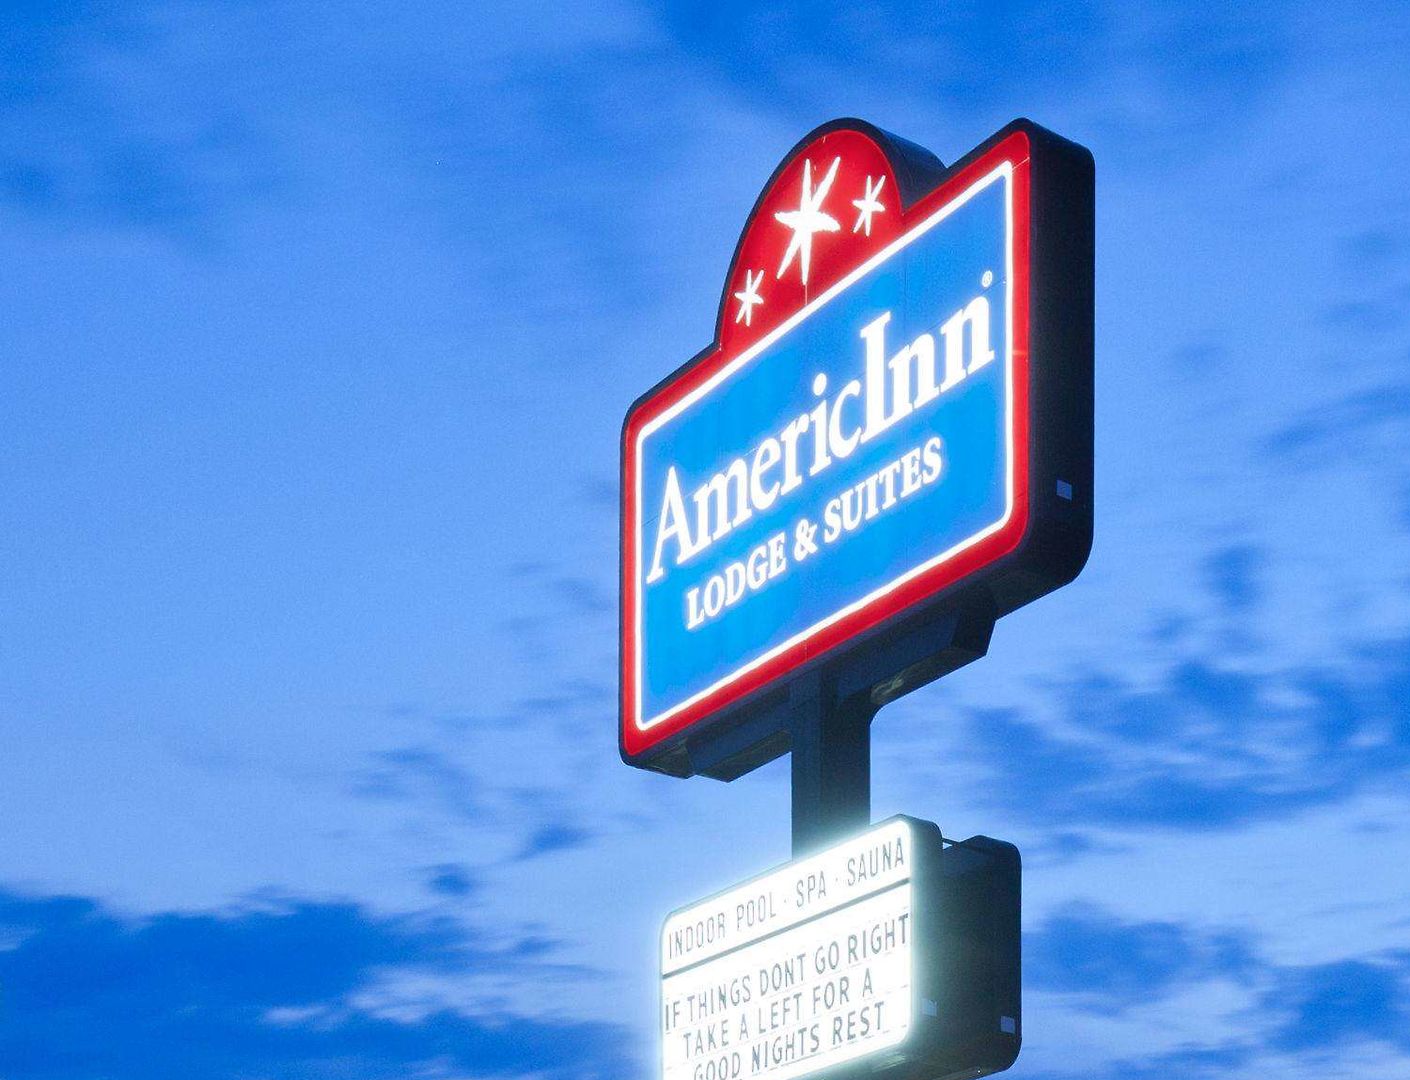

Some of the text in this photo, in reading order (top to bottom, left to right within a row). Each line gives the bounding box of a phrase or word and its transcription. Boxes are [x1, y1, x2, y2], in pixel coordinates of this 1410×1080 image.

[647, 295, 994, 583] AmericInn
[686, 436, 943, 630] LODGE & SUITES
[669, 838, 905, 959] INDOOR POOL SPA SAUNA
[665, 913, 909, 1031] IF THINGS DONT GO RIGHT
[683, 967, 873, 1059] TAKE A LEFT FOR A
[751, 1022, 820, 1072] NIGHTS
[832, 1002, 884, 1045] REST
